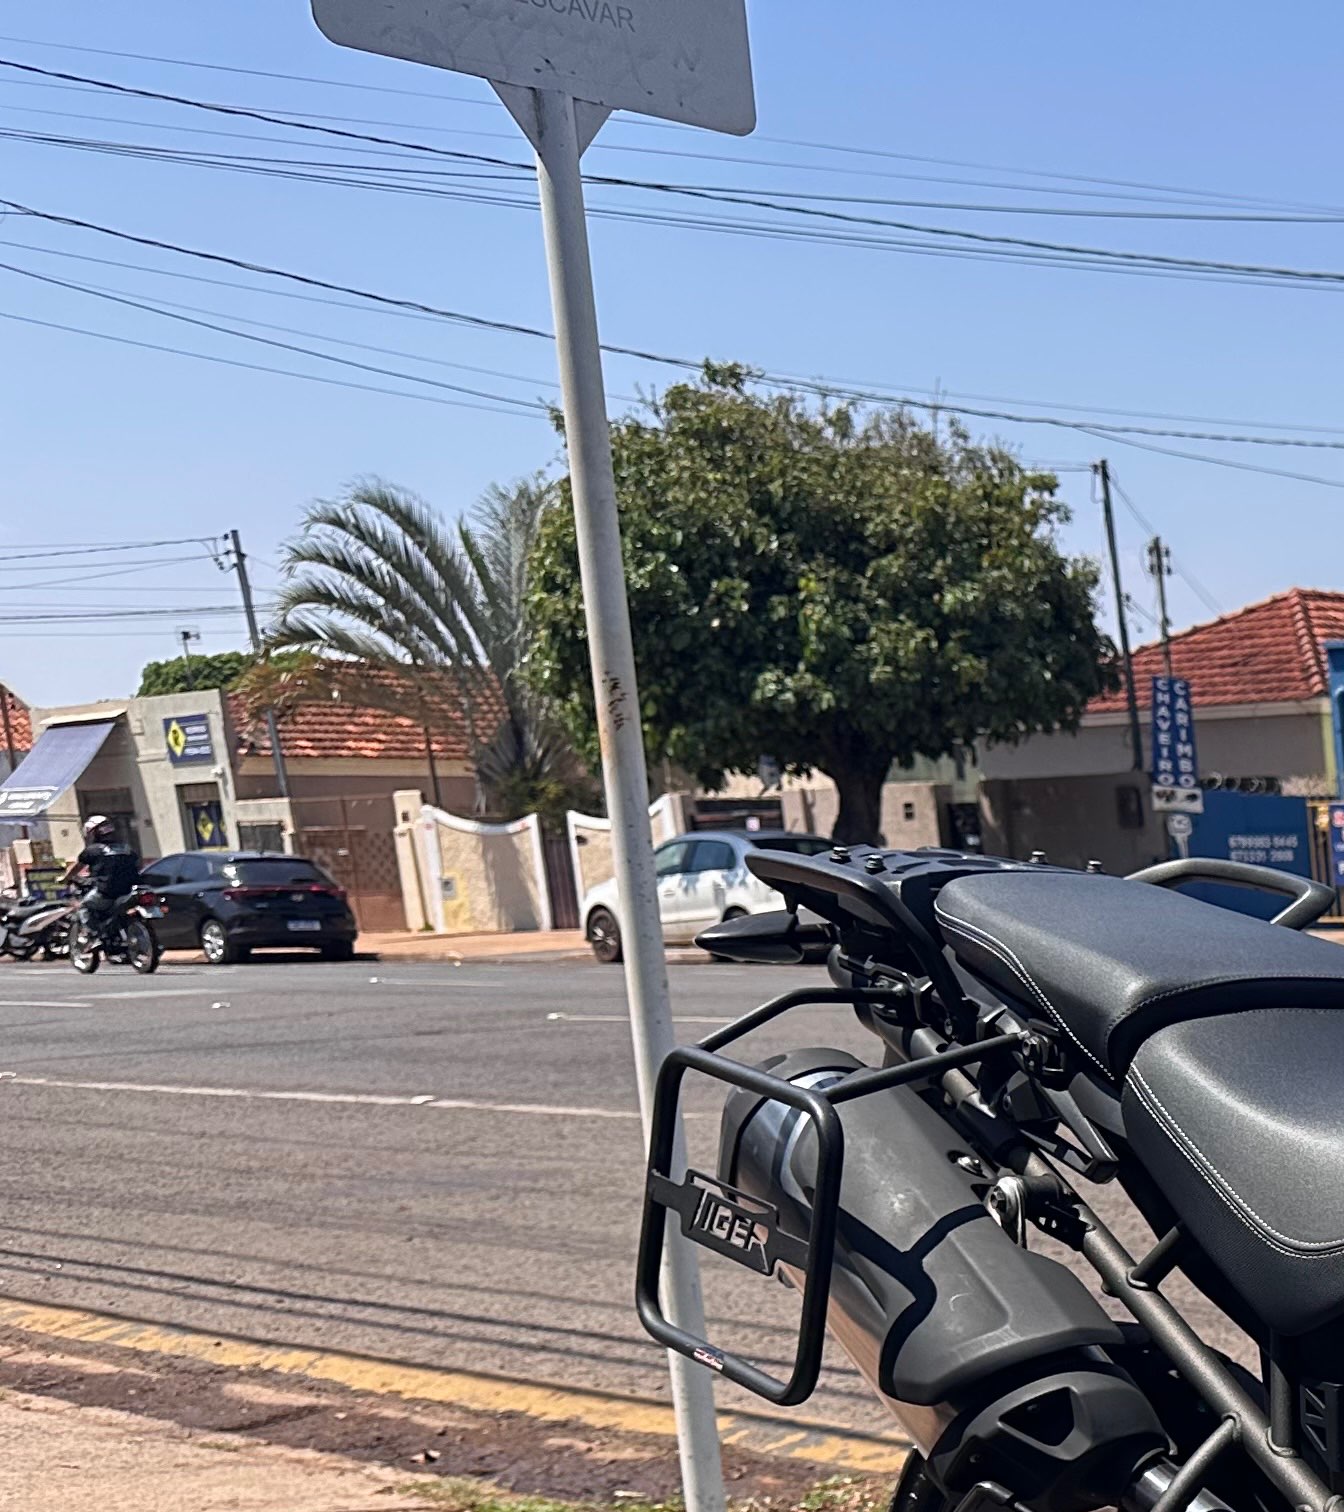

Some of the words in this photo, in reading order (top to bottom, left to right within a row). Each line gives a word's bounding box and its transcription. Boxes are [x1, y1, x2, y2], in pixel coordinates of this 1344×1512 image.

[516, 0, 636, 32] CAVAR
[1156, 679, 1174, 786] CHAVEIRO
[1173, 681, 1196, 788] CARIMBO
[690, 1176, 771, 1273] TIGER
